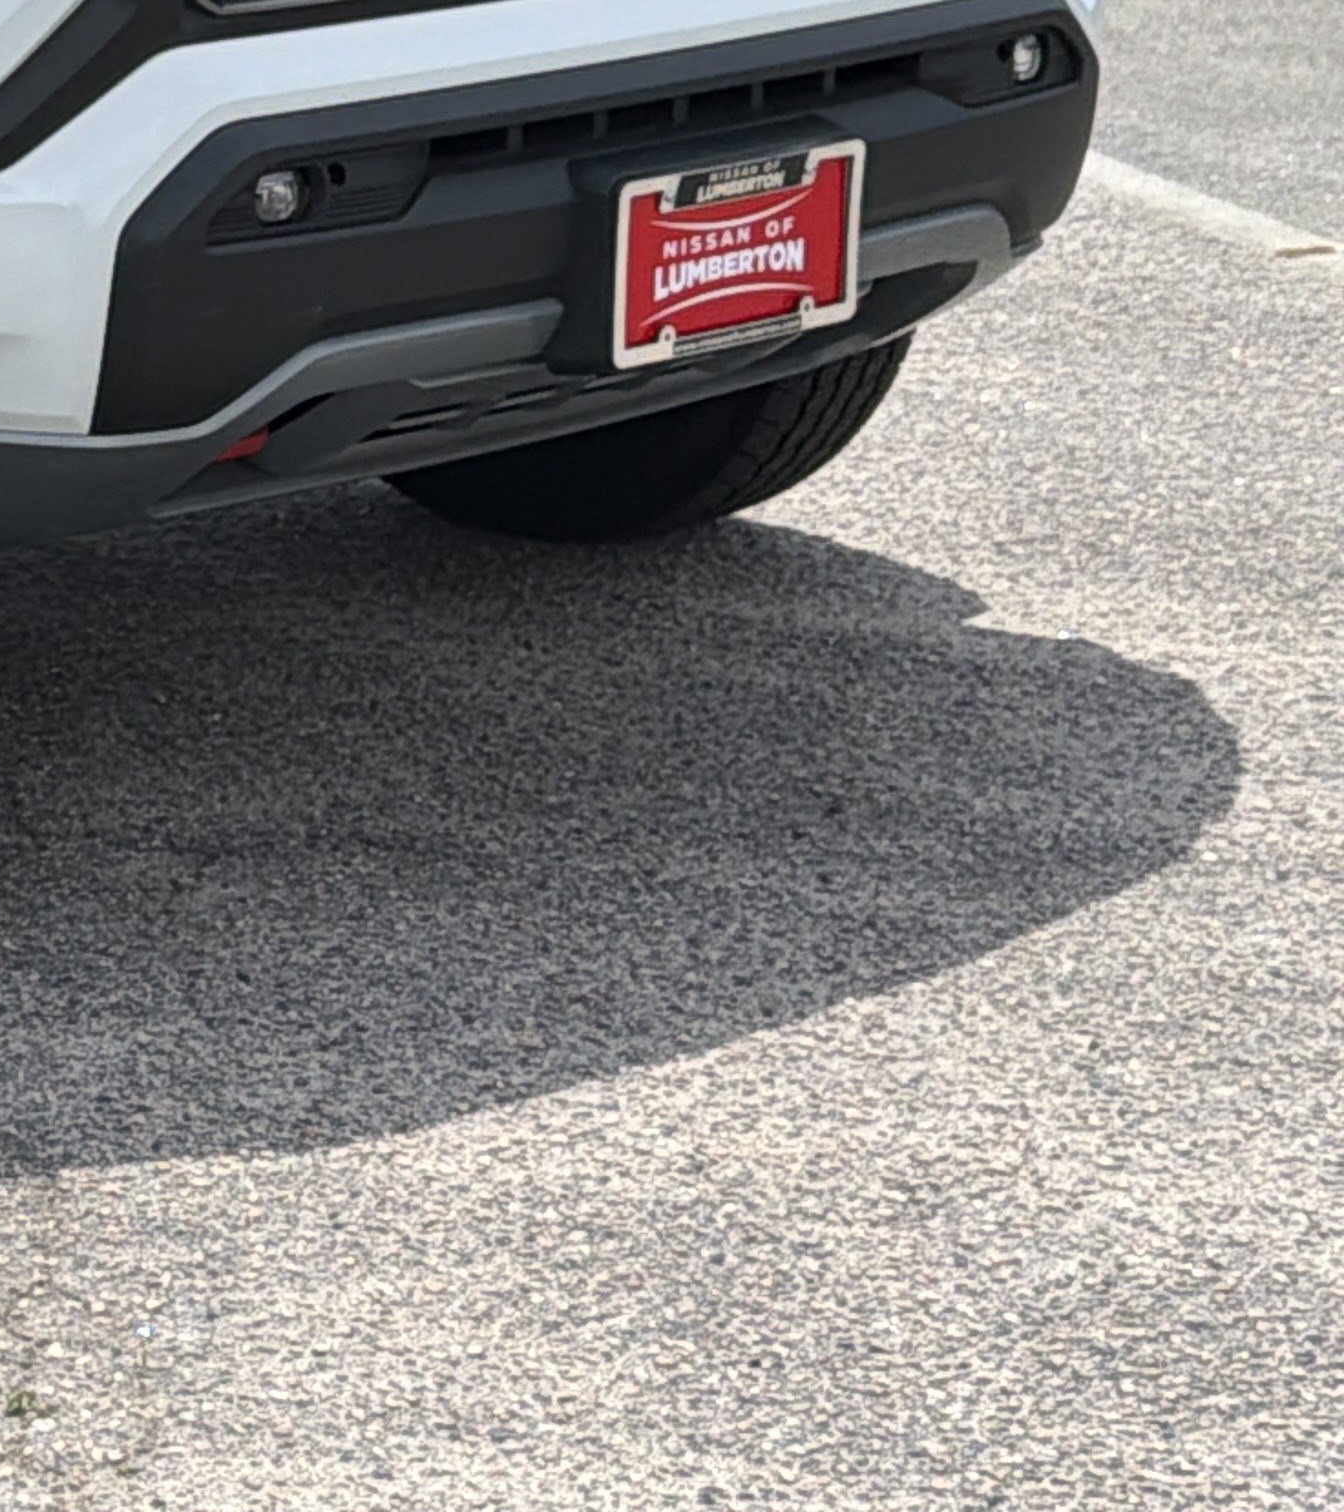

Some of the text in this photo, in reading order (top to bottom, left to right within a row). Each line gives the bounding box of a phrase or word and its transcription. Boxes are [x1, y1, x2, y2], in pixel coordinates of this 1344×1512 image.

[663, 216, 795, 259] NISSAN OF
[653, 237, 805, 301] LUMBERTON
